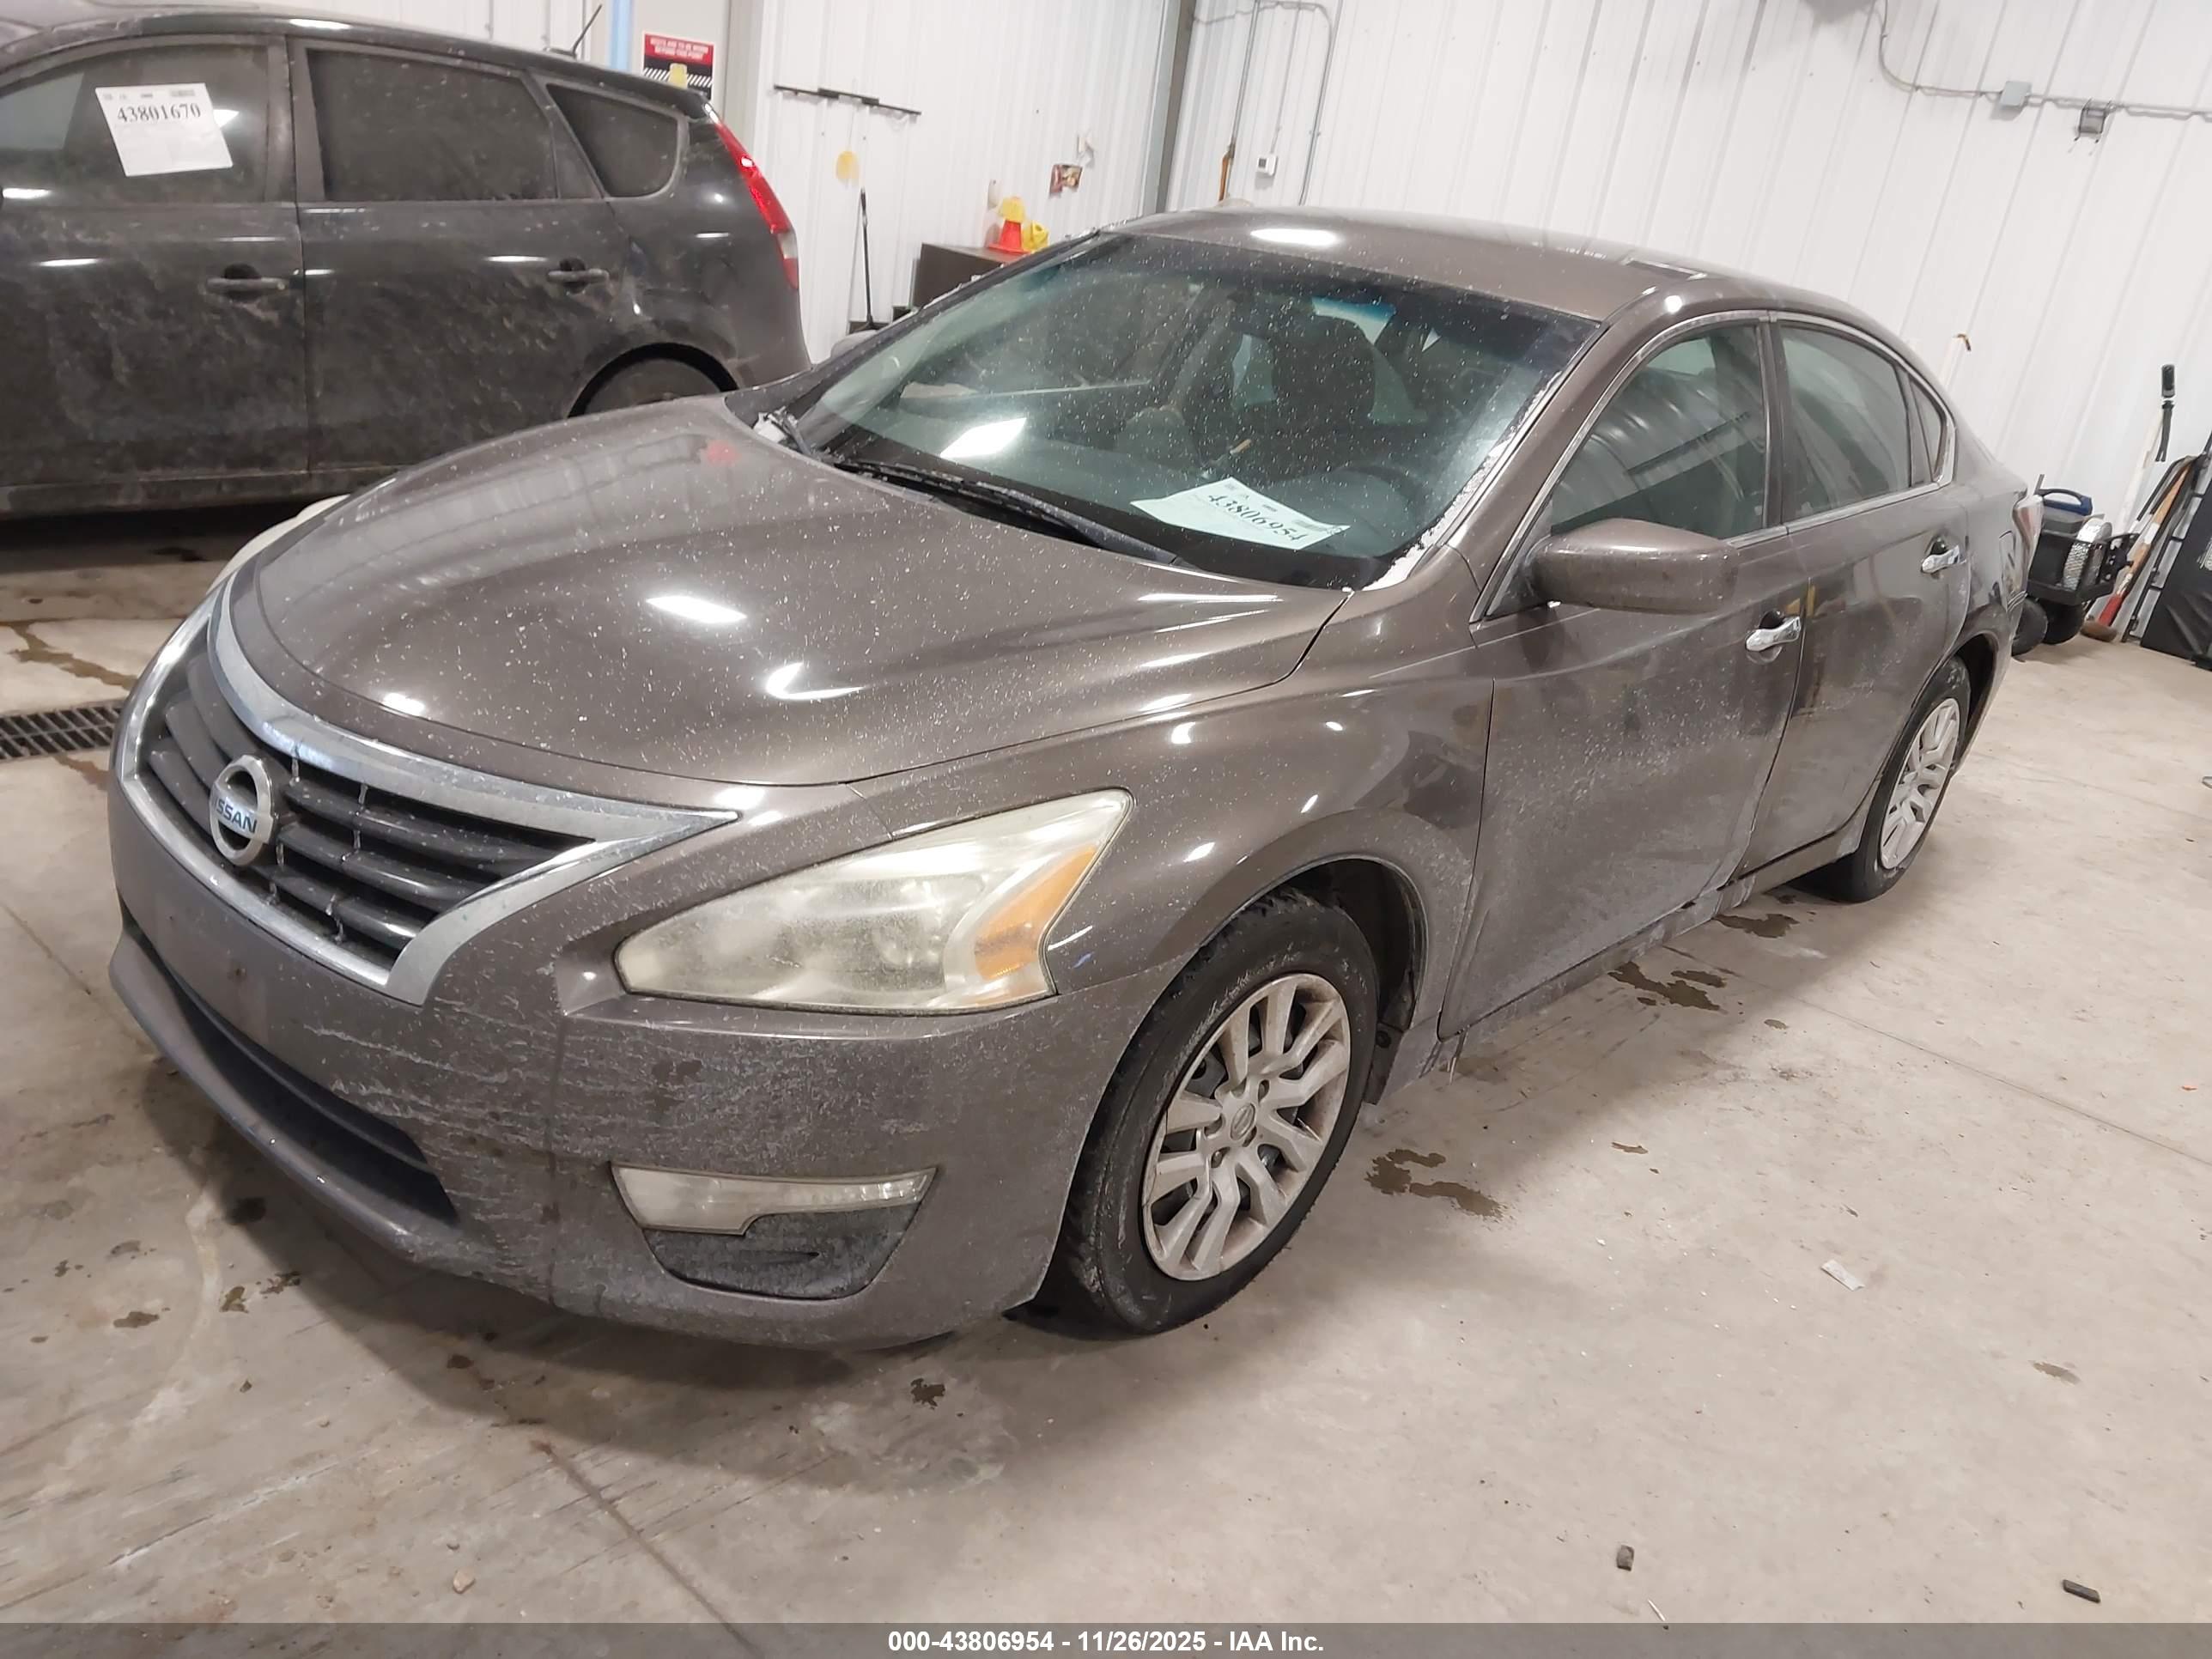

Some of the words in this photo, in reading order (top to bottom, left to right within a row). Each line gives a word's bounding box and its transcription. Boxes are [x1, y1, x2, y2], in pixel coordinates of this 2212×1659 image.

[117, 103, 201, 122] 43801670
[1208, 495, 1308, 541] 43806954
[211, 796, 258, 834] ISSAN
